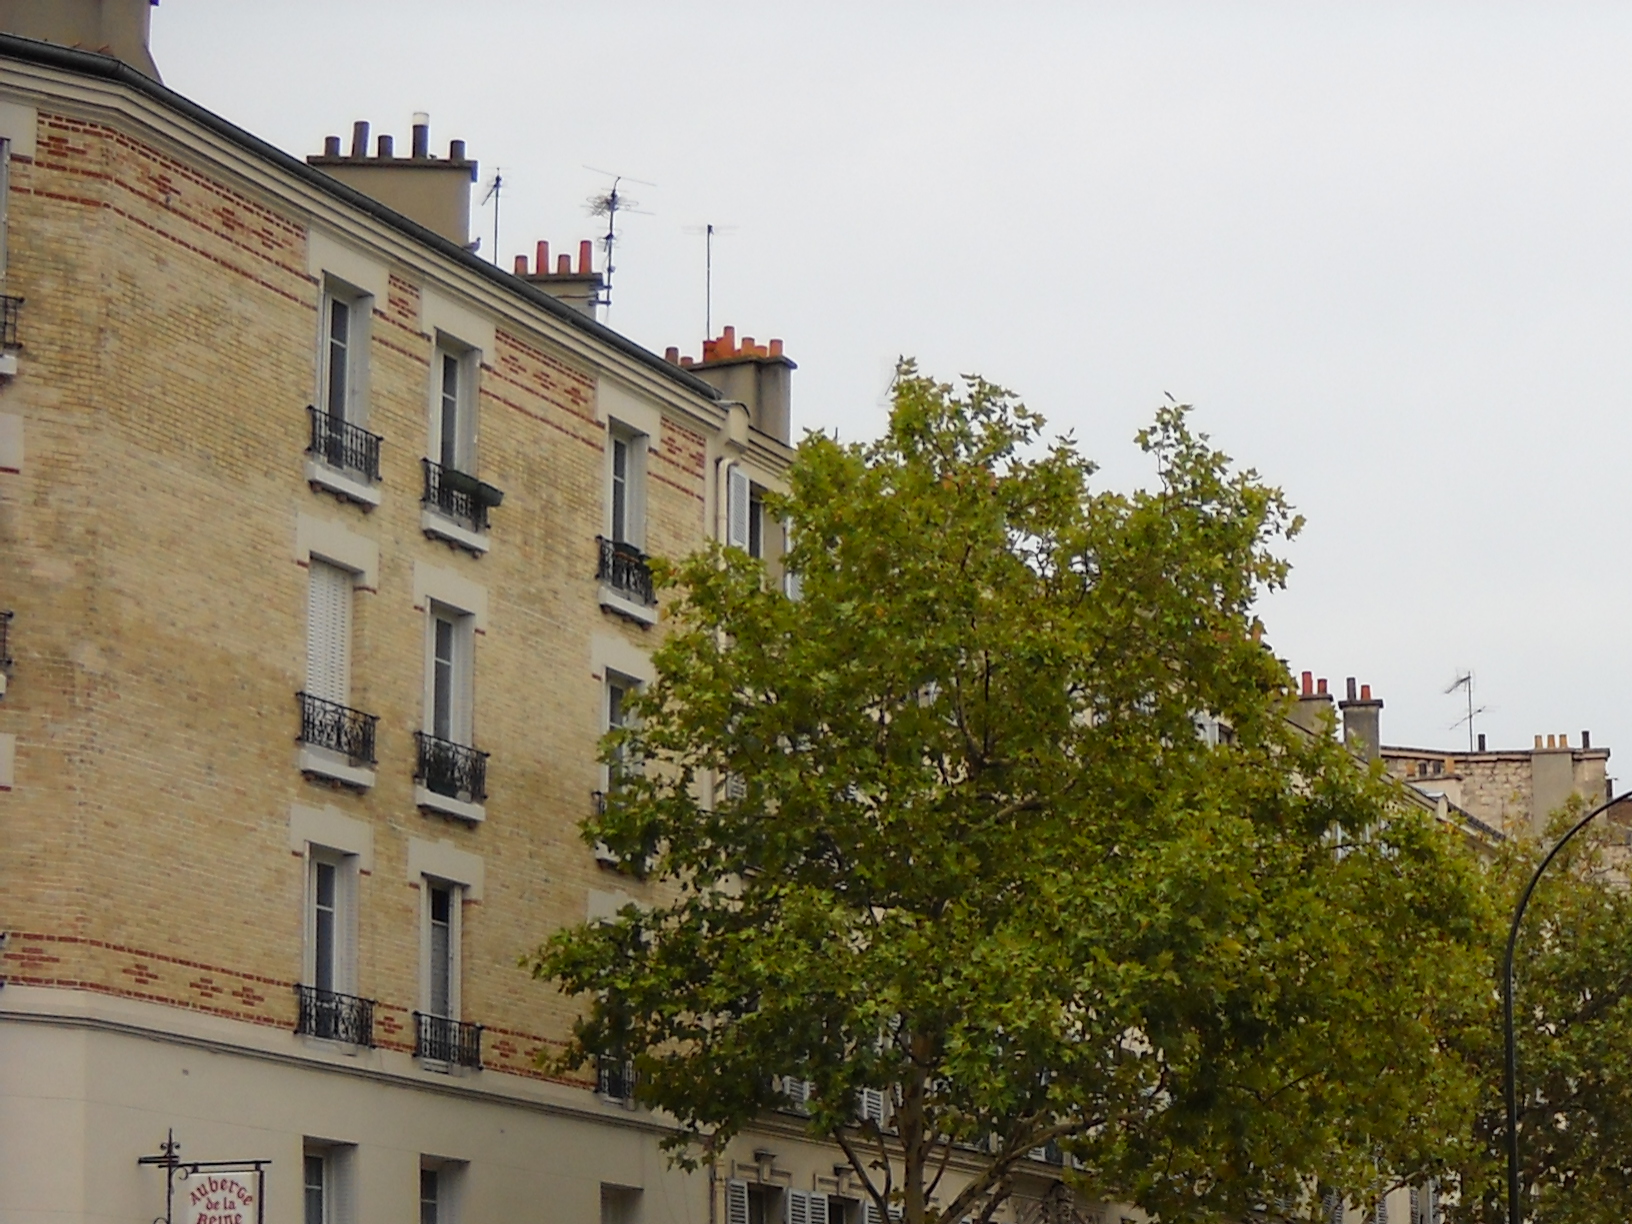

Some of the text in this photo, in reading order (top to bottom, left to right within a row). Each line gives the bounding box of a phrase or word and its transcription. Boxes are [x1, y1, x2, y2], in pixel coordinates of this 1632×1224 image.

[190, 1176, 254, 1206] Auberge
[205, 1197, 236, 1211] de la
